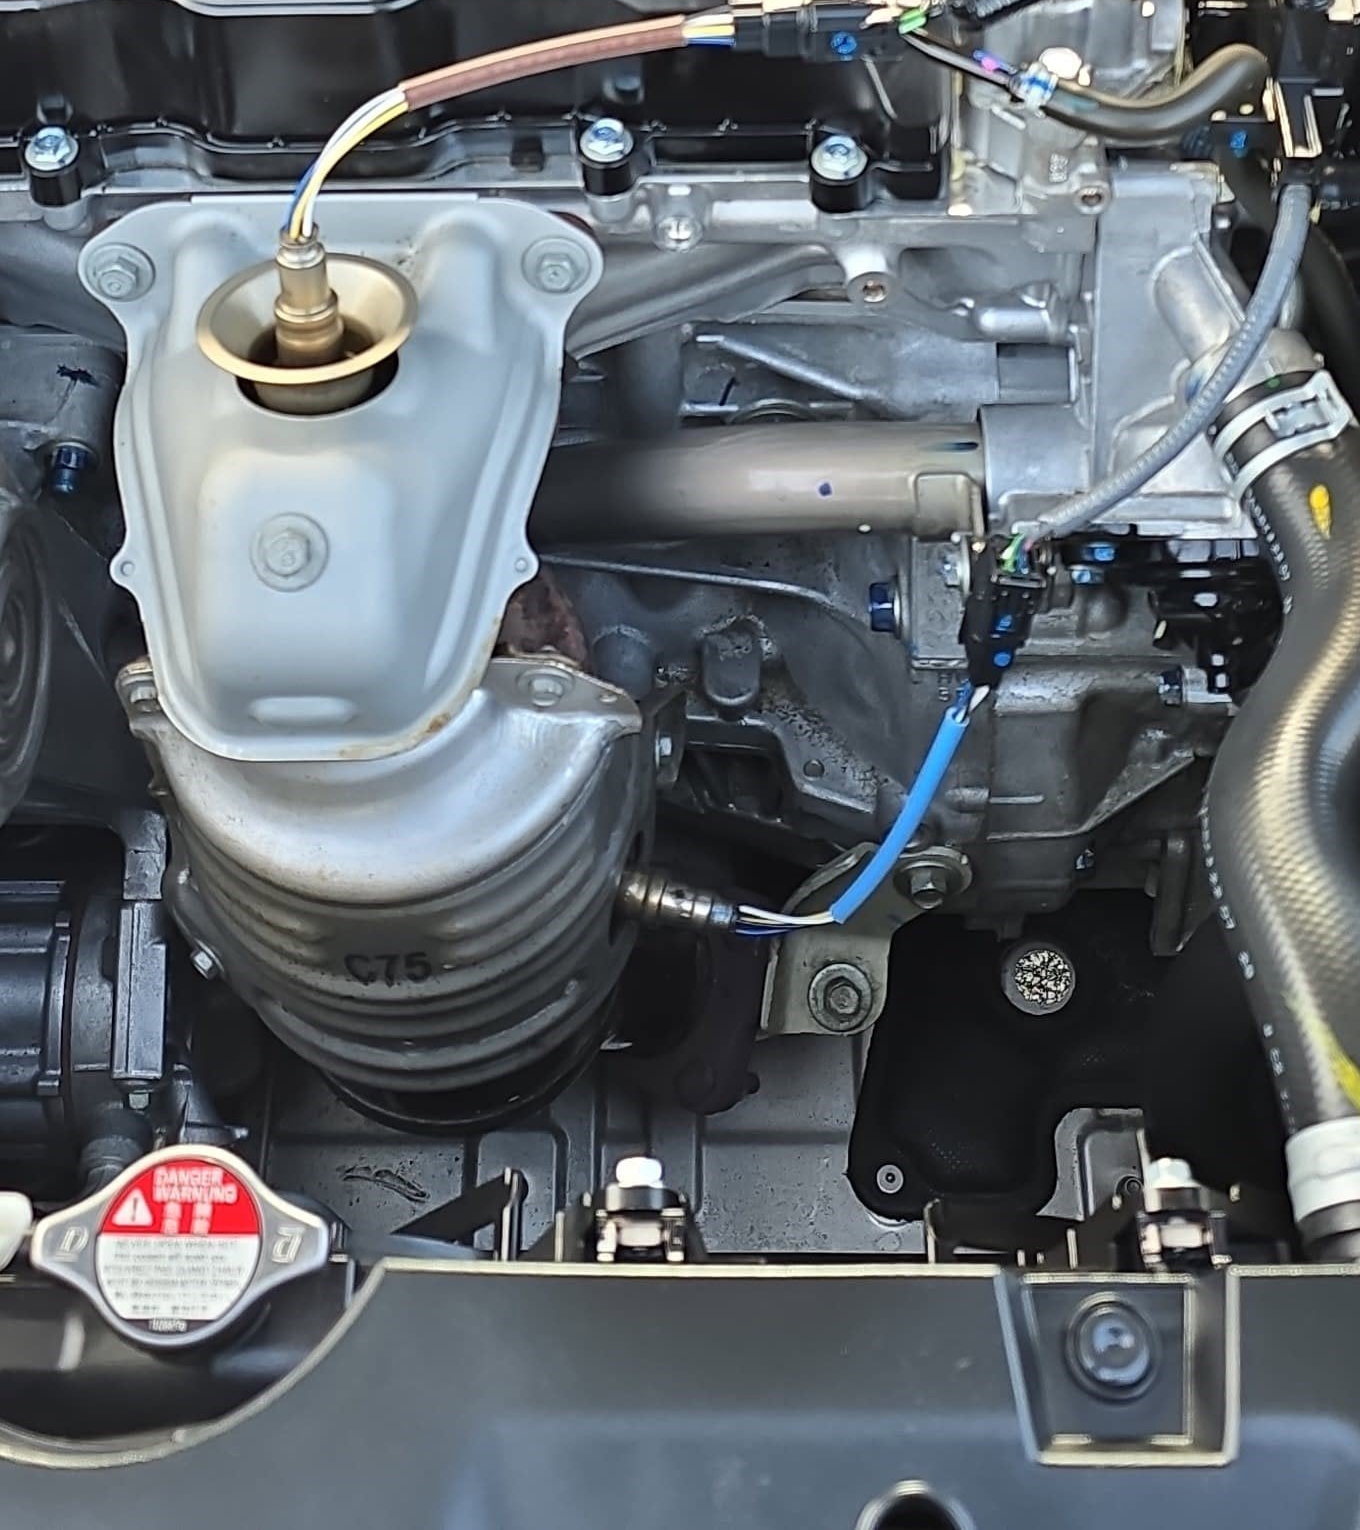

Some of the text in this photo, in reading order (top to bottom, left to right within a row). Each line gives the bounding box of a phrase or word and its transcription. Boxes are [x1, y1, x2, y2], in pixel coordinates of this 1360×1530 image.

[344, 952, 433, 986] C75
[153, 1166, 224, 1186] DANGER
[153, 1183, 238, 1204] WARNING
